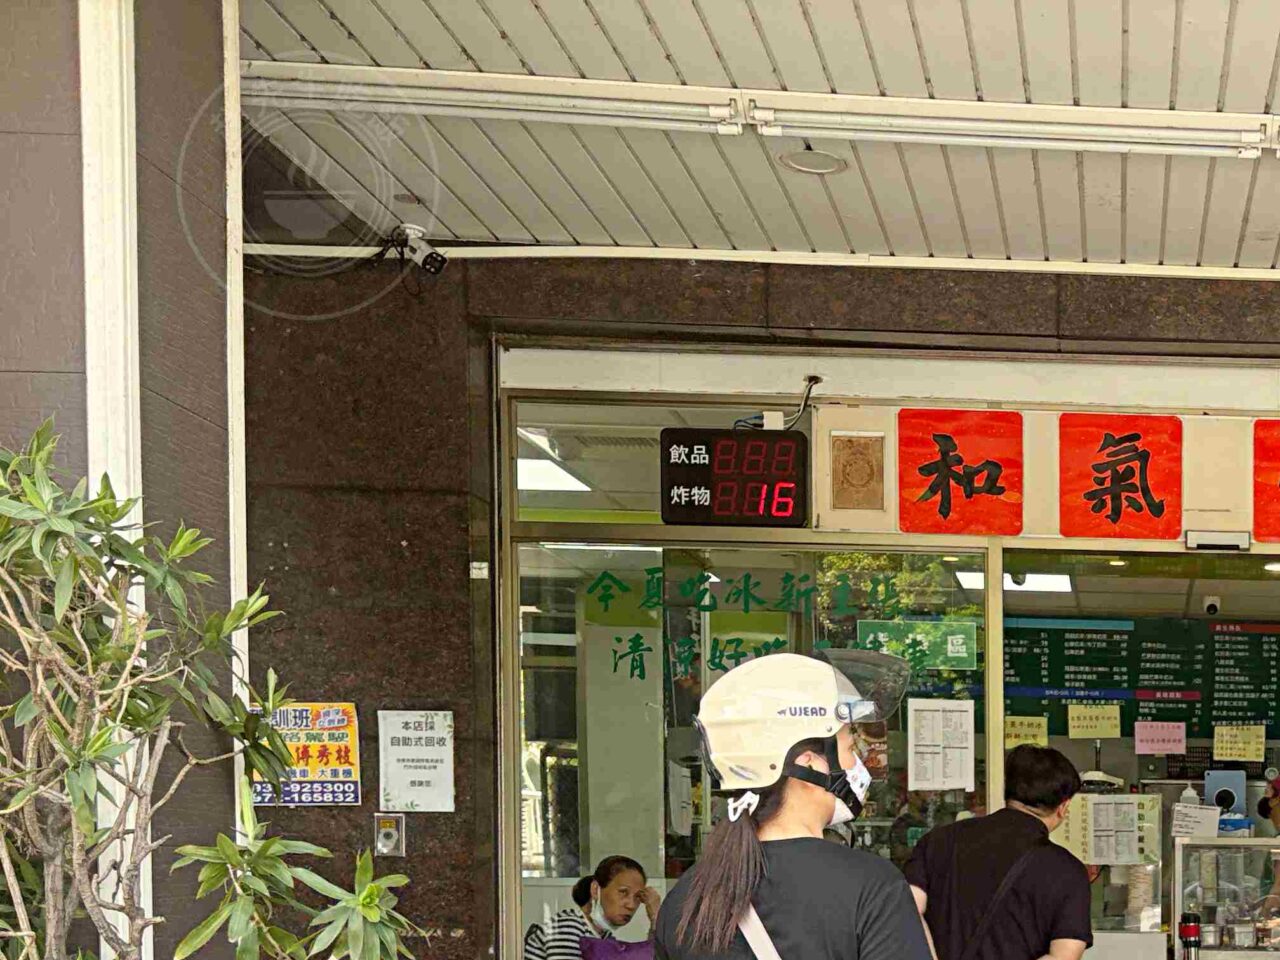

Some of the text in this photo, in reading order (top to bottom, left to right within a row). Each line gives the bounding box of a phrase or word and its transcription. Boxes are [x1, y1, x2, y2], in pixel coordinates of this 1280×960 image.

[669, 445, 710, 465] 飲品
[670, 486, 711, 506] 炸物
[757, 483, 796, 517] 16
[390, 736, 447, 747] 自助式回收
